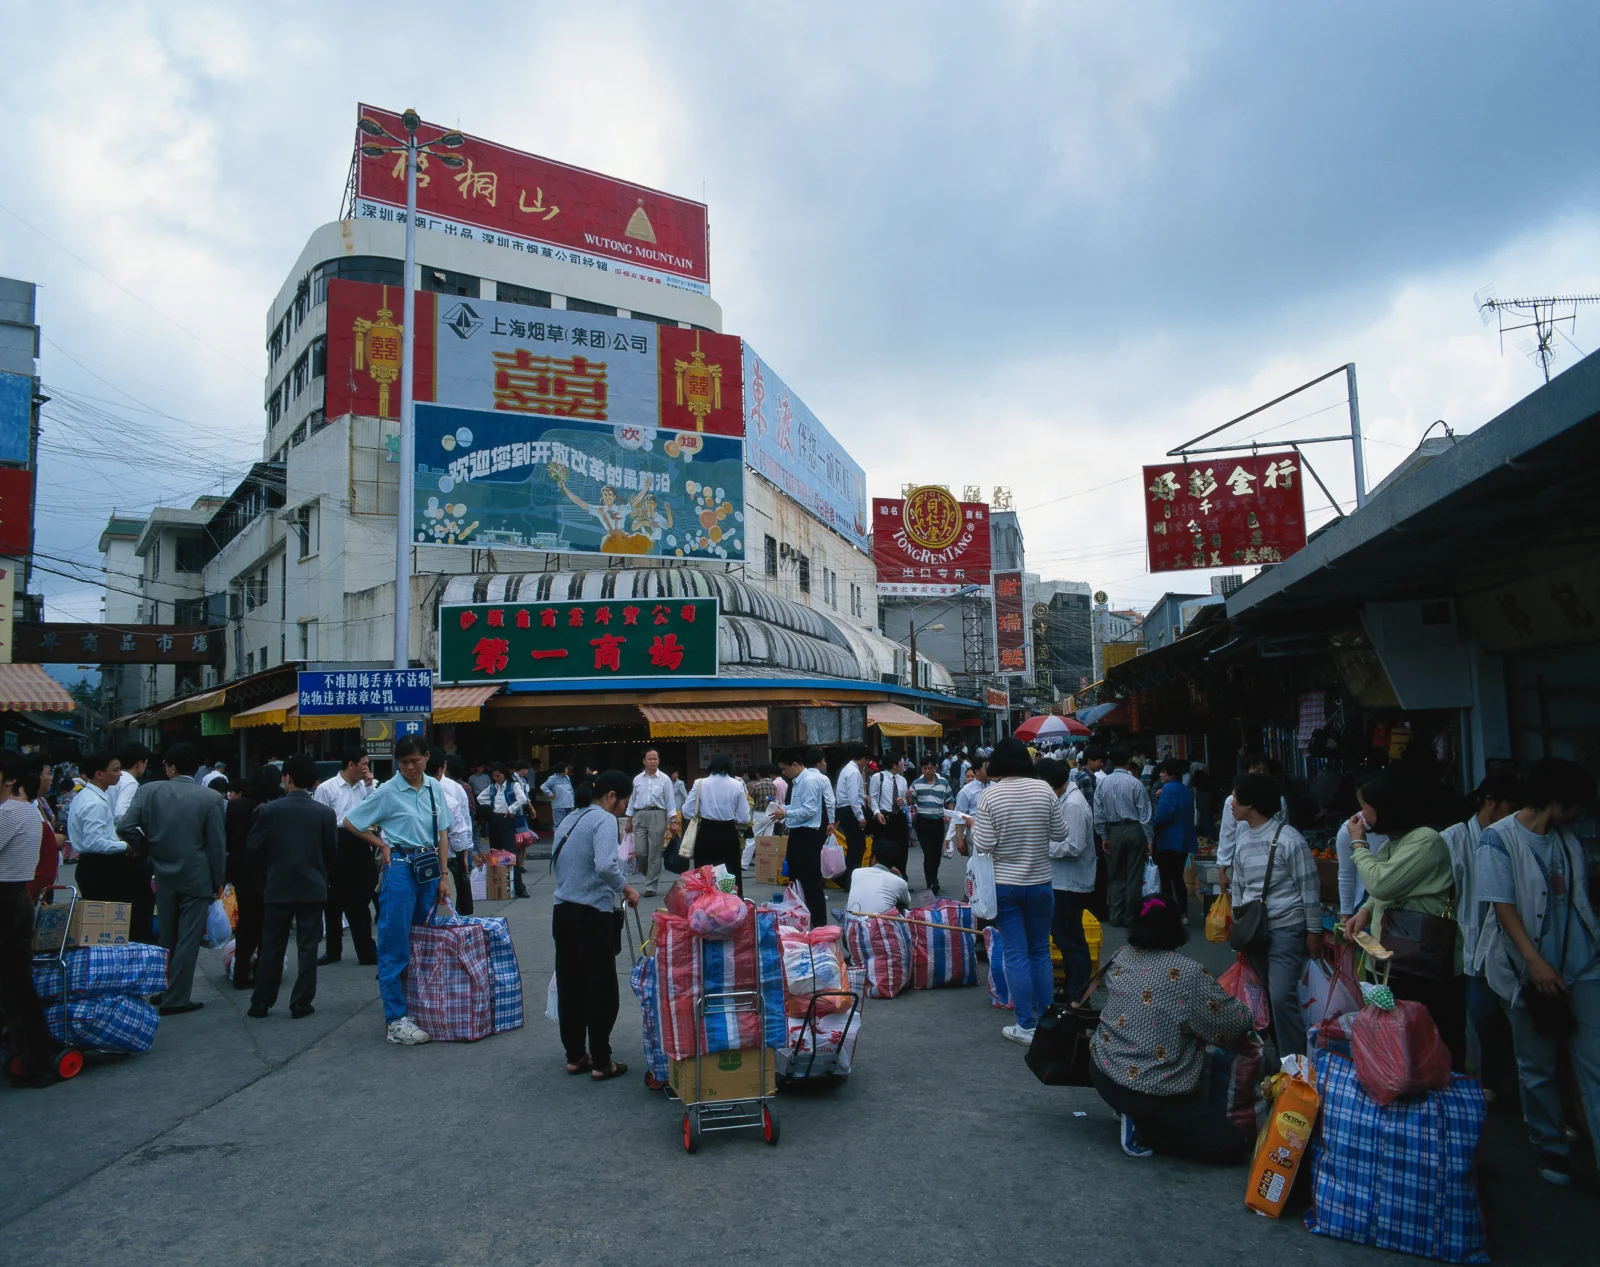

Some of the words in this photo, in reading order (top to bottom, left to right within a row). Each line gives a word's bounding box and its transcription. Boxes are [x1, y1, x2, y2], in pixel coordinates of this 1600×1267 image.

[584, 233, 633, 254] WUTONG
[635, 247, 693, 270] MOUNTAIN
[489, 316, 648, 354] 上海烟草(集团)公司
[448, 441, 671, 493] 欢迎您到开放改革的最前沿
[925, 499, 939, 542] 同仁堂
[472, 632, 684, 675] 第一商場
[1282, 1112, 1308, 1128] PETPET
